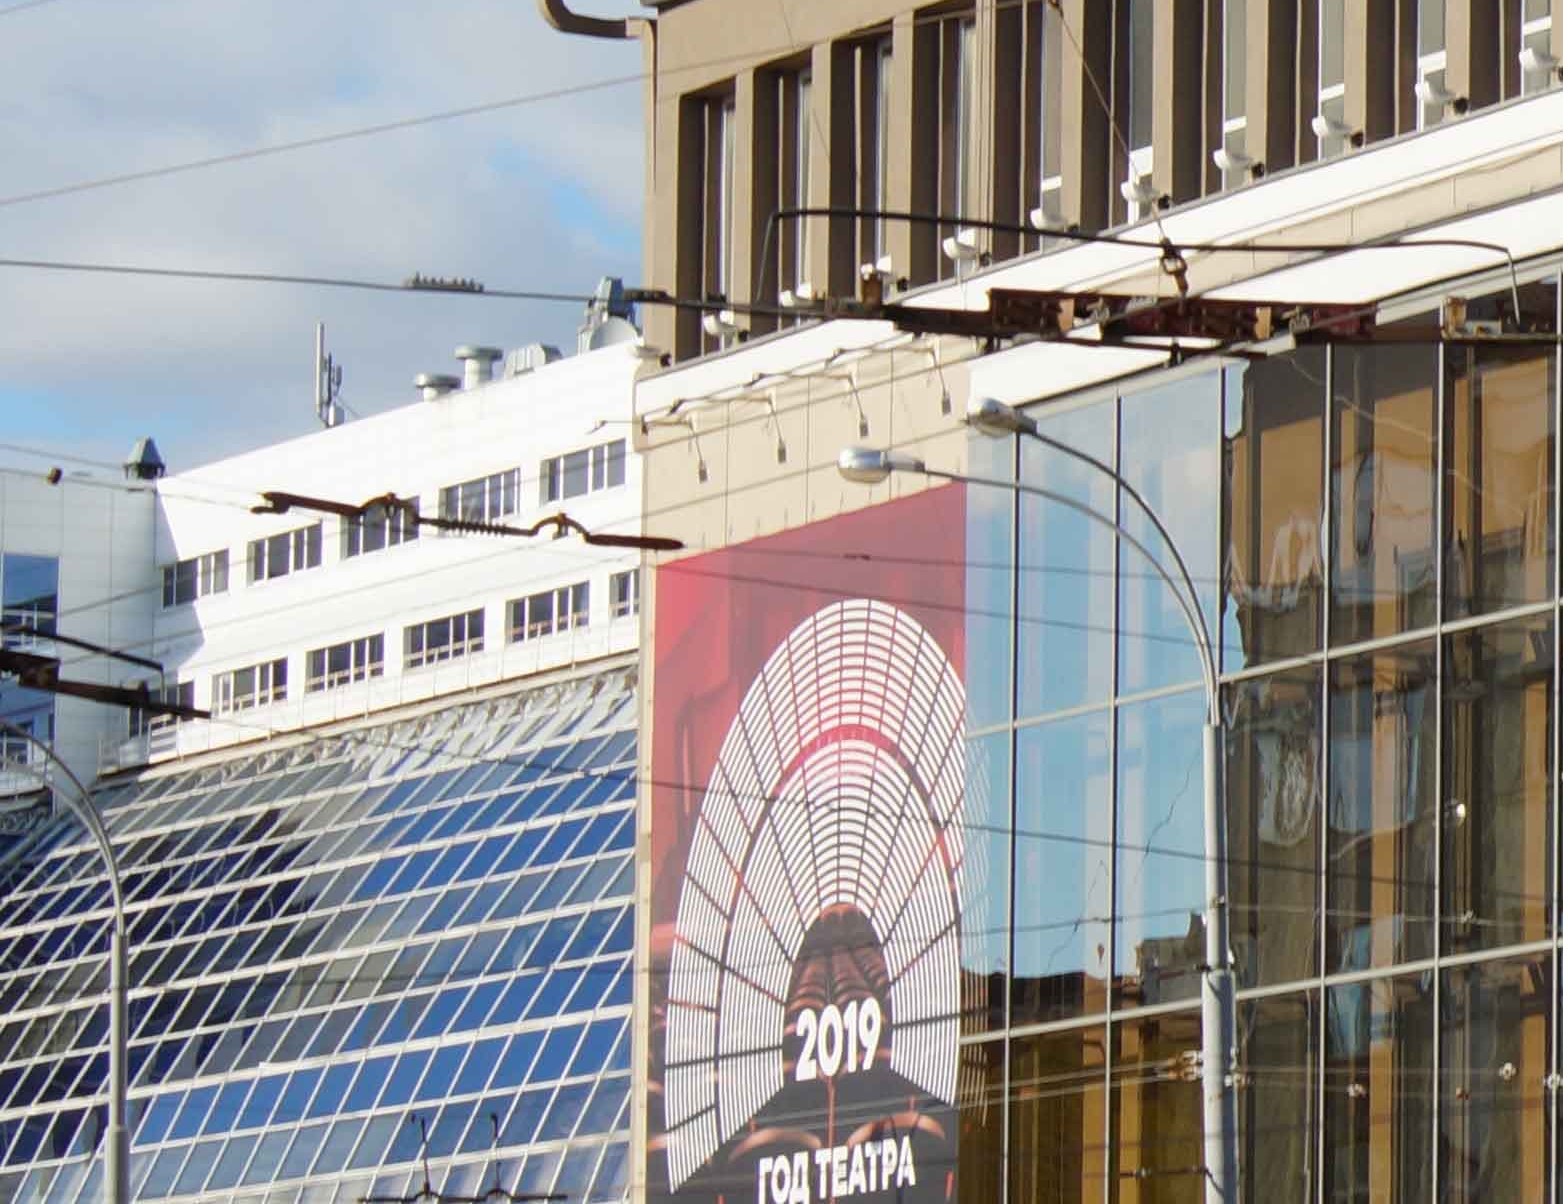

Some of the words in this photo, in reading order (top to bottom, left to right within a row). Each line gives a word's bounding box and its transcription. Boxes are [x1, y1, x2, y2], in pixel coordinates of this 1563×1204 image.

[795, 997, 882, 1082] 2019
[758, 1150, 811, 1204] ГОД
[815, 1134, 917, 1200] ТЕАТРА
